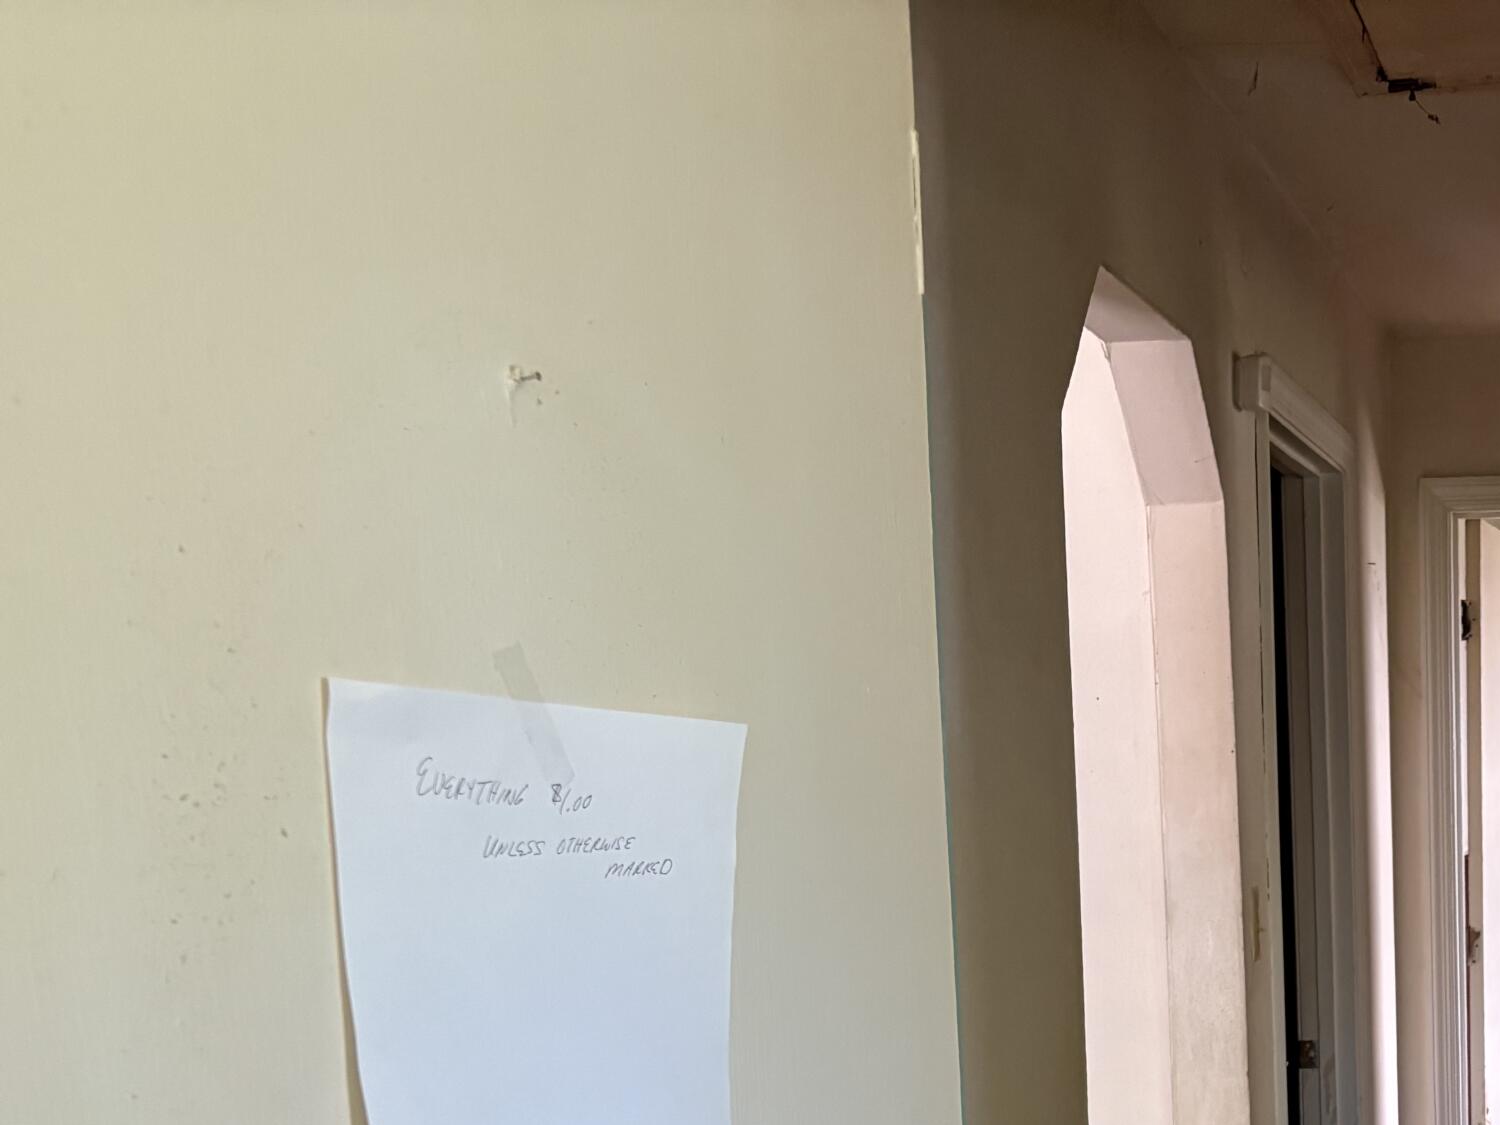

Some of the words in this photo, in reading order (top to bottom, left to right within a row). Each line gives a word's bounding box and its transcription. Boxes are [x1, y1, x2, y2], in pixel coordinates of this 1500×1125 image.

[550, 783, 593, 815] $1.00
[482, 835, 546, 859] UNLESS
[556, 835, 636, 856] OTHERWISE
[604, 858, 673, 879] MARKED
